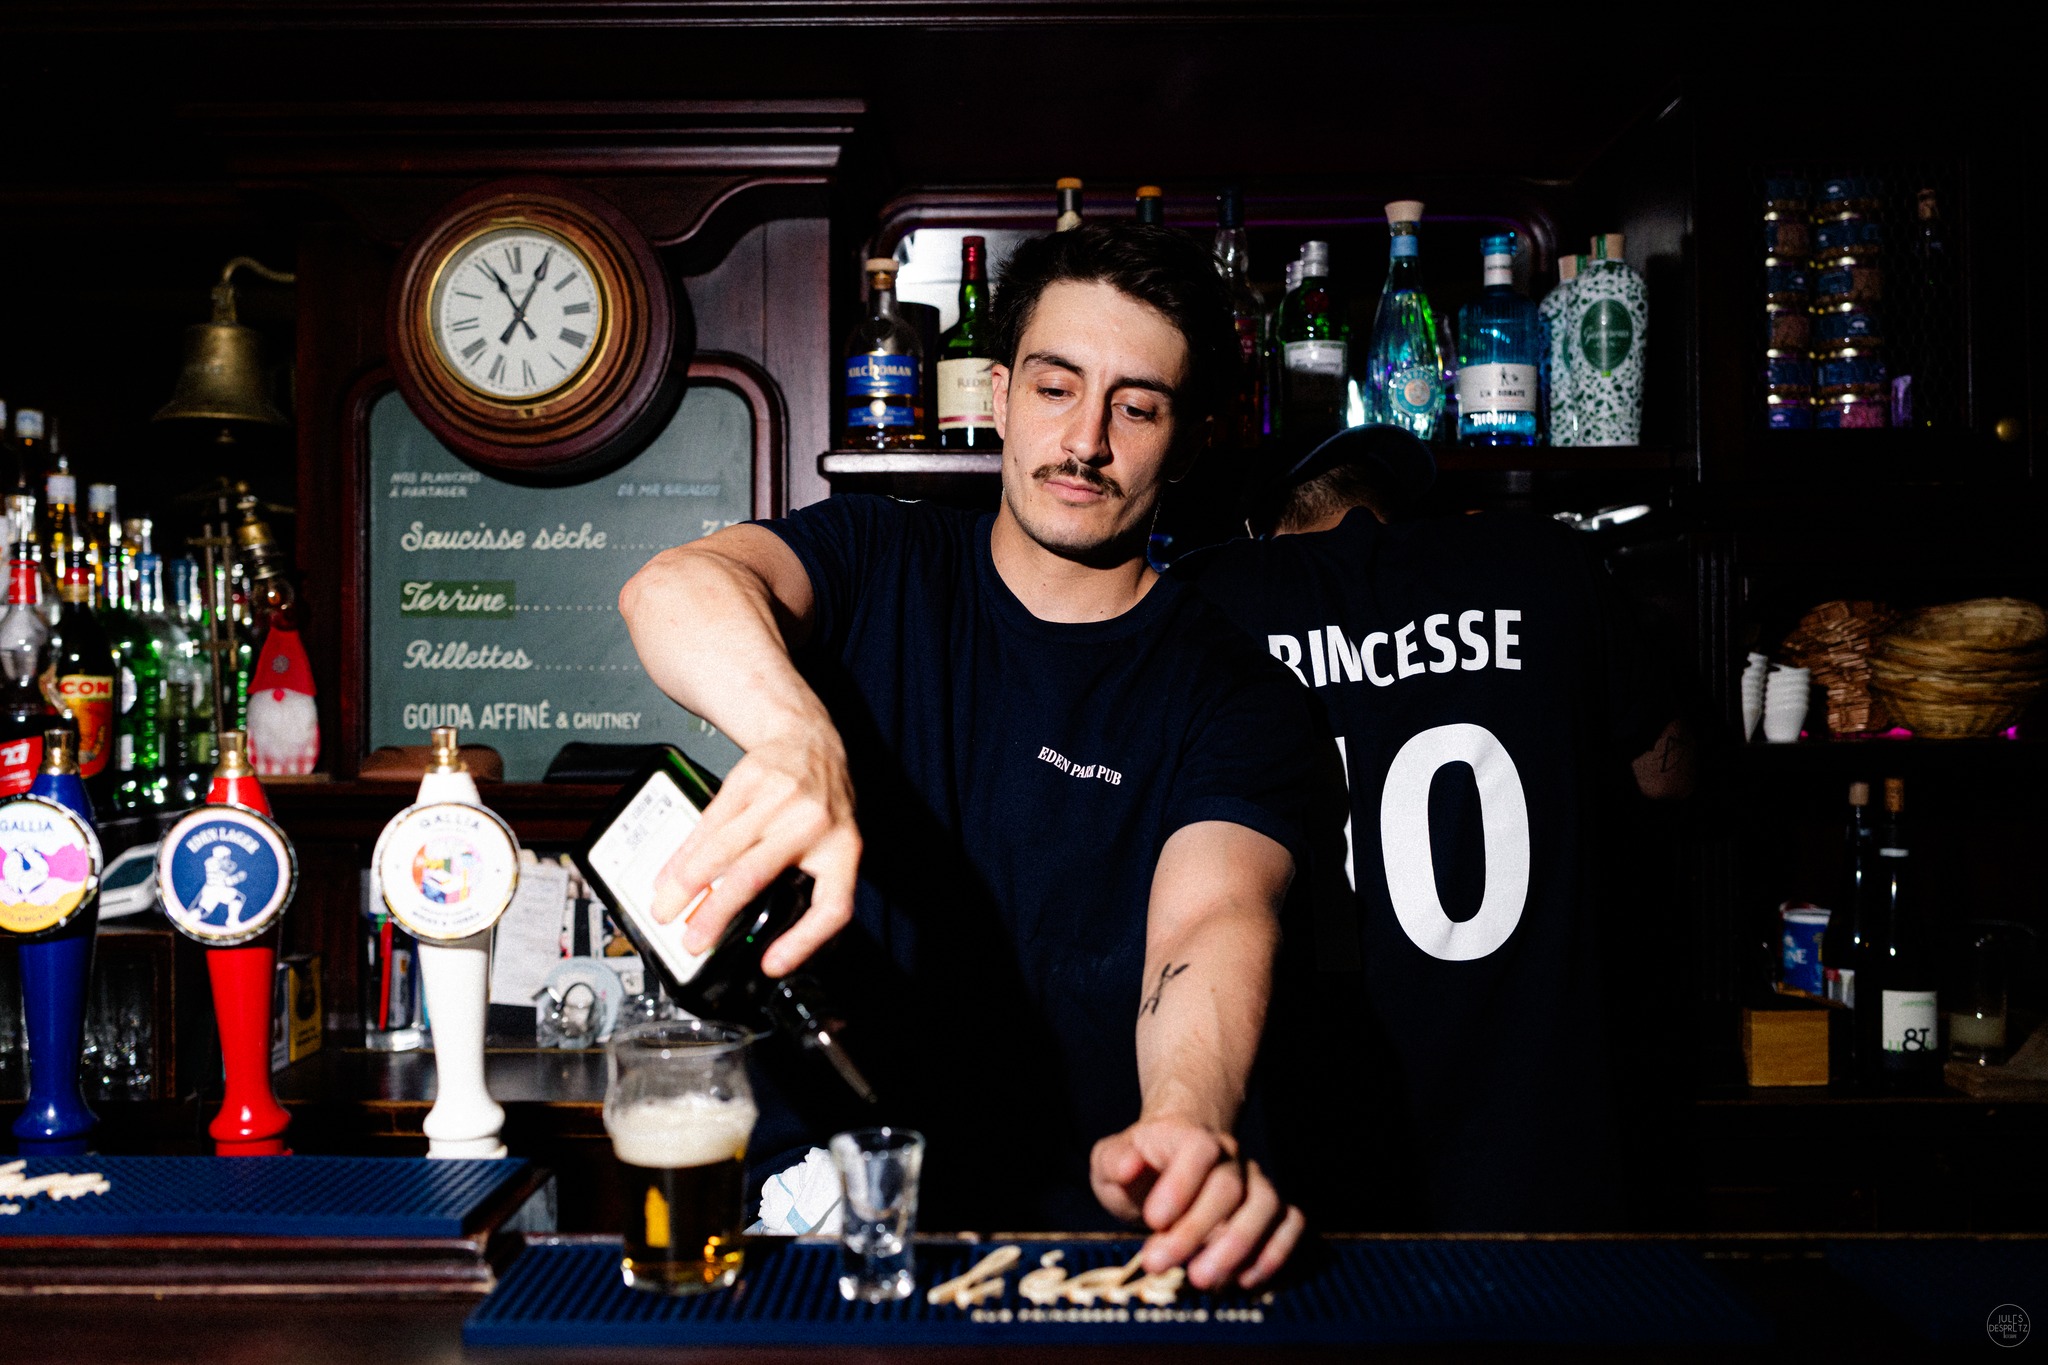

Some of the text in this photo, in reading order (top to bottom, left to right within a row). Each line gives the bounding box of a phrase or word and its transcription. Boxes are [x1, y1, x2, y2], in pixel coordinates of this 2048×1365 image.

[401, 521, 527, 551] Saucisse
[532, 522, 608, 550] sèche
[401, 581, 507, 612] Terrine
[403, 639, 530, 670] Rillettes
[403, 699, 642, 730] GOUDA AFFINÉ & CHUTNEY
[1037, 745, 1072, 773] EDEN
[1096, 764, 1123, 786] PUB
